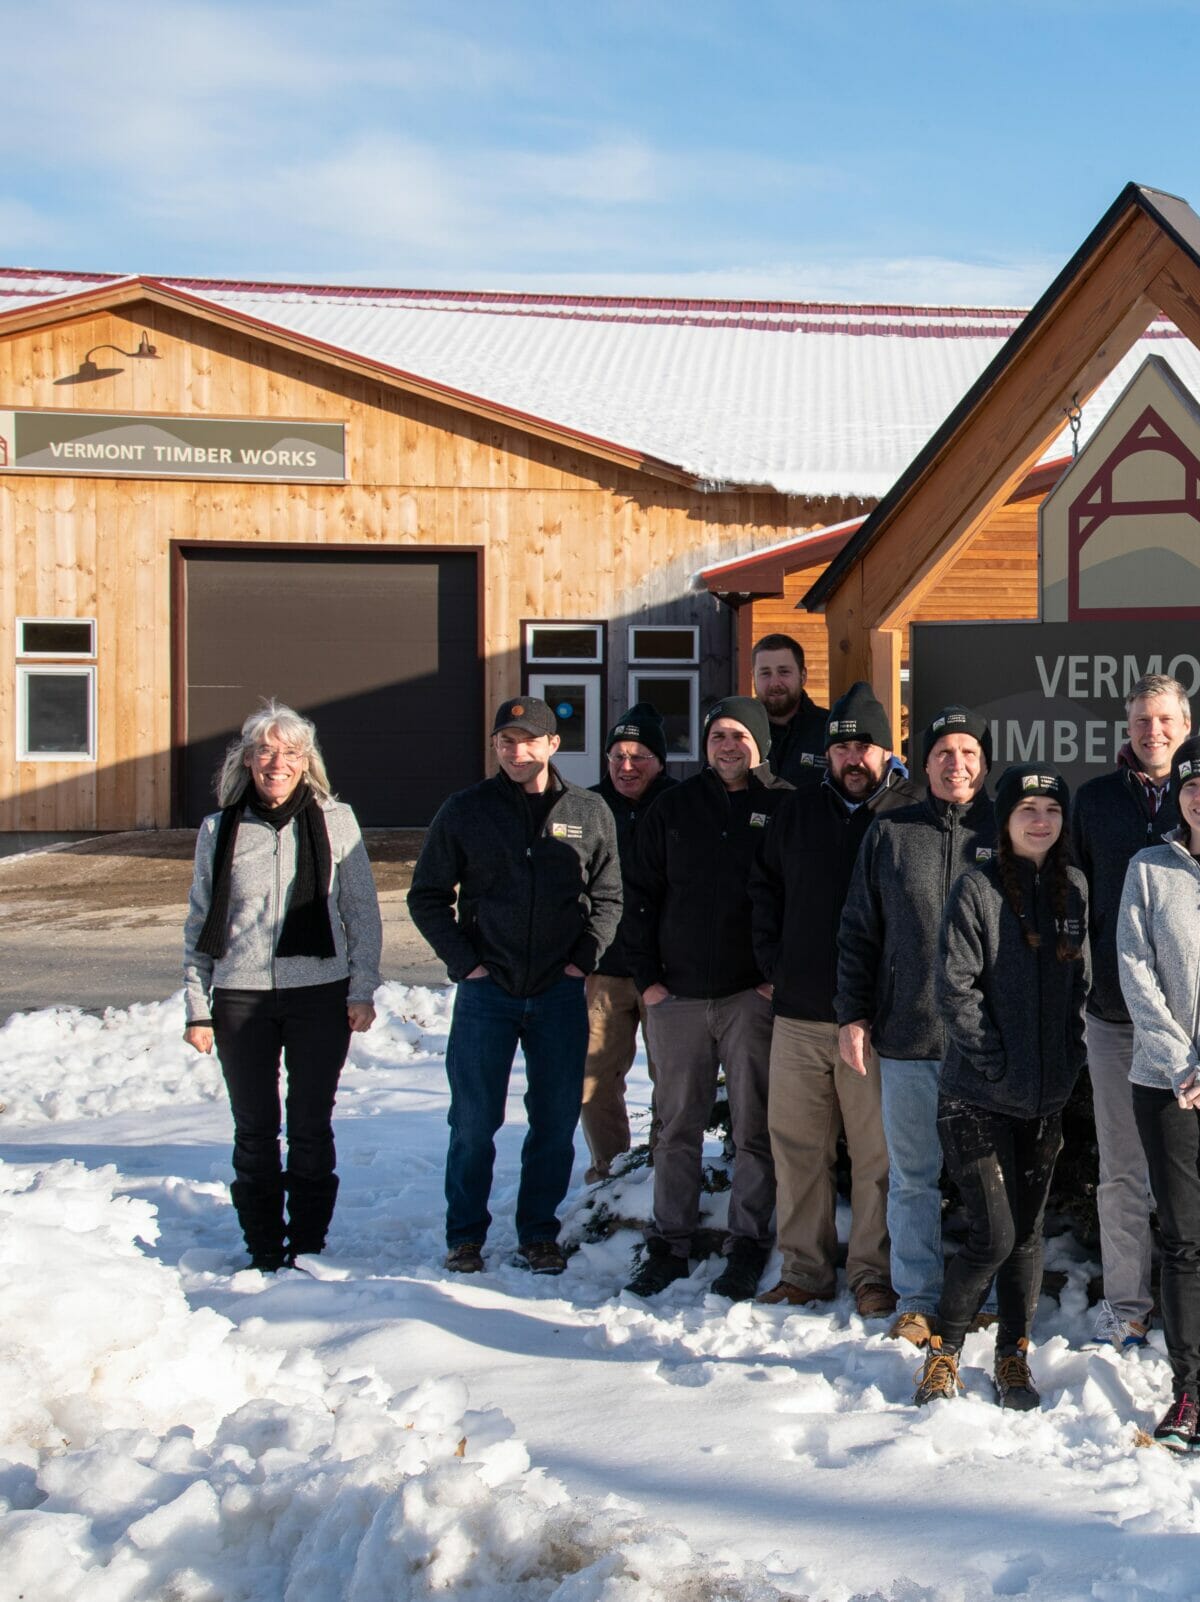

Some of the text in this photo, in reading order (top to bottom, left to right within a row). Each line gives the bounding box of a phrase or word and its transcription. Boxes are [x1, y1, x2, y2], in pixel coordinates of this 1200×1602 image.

[49, 442, 317, 467] VERMONT TIMBER WORKS
[991, 719, 1130, 763] IMBE
